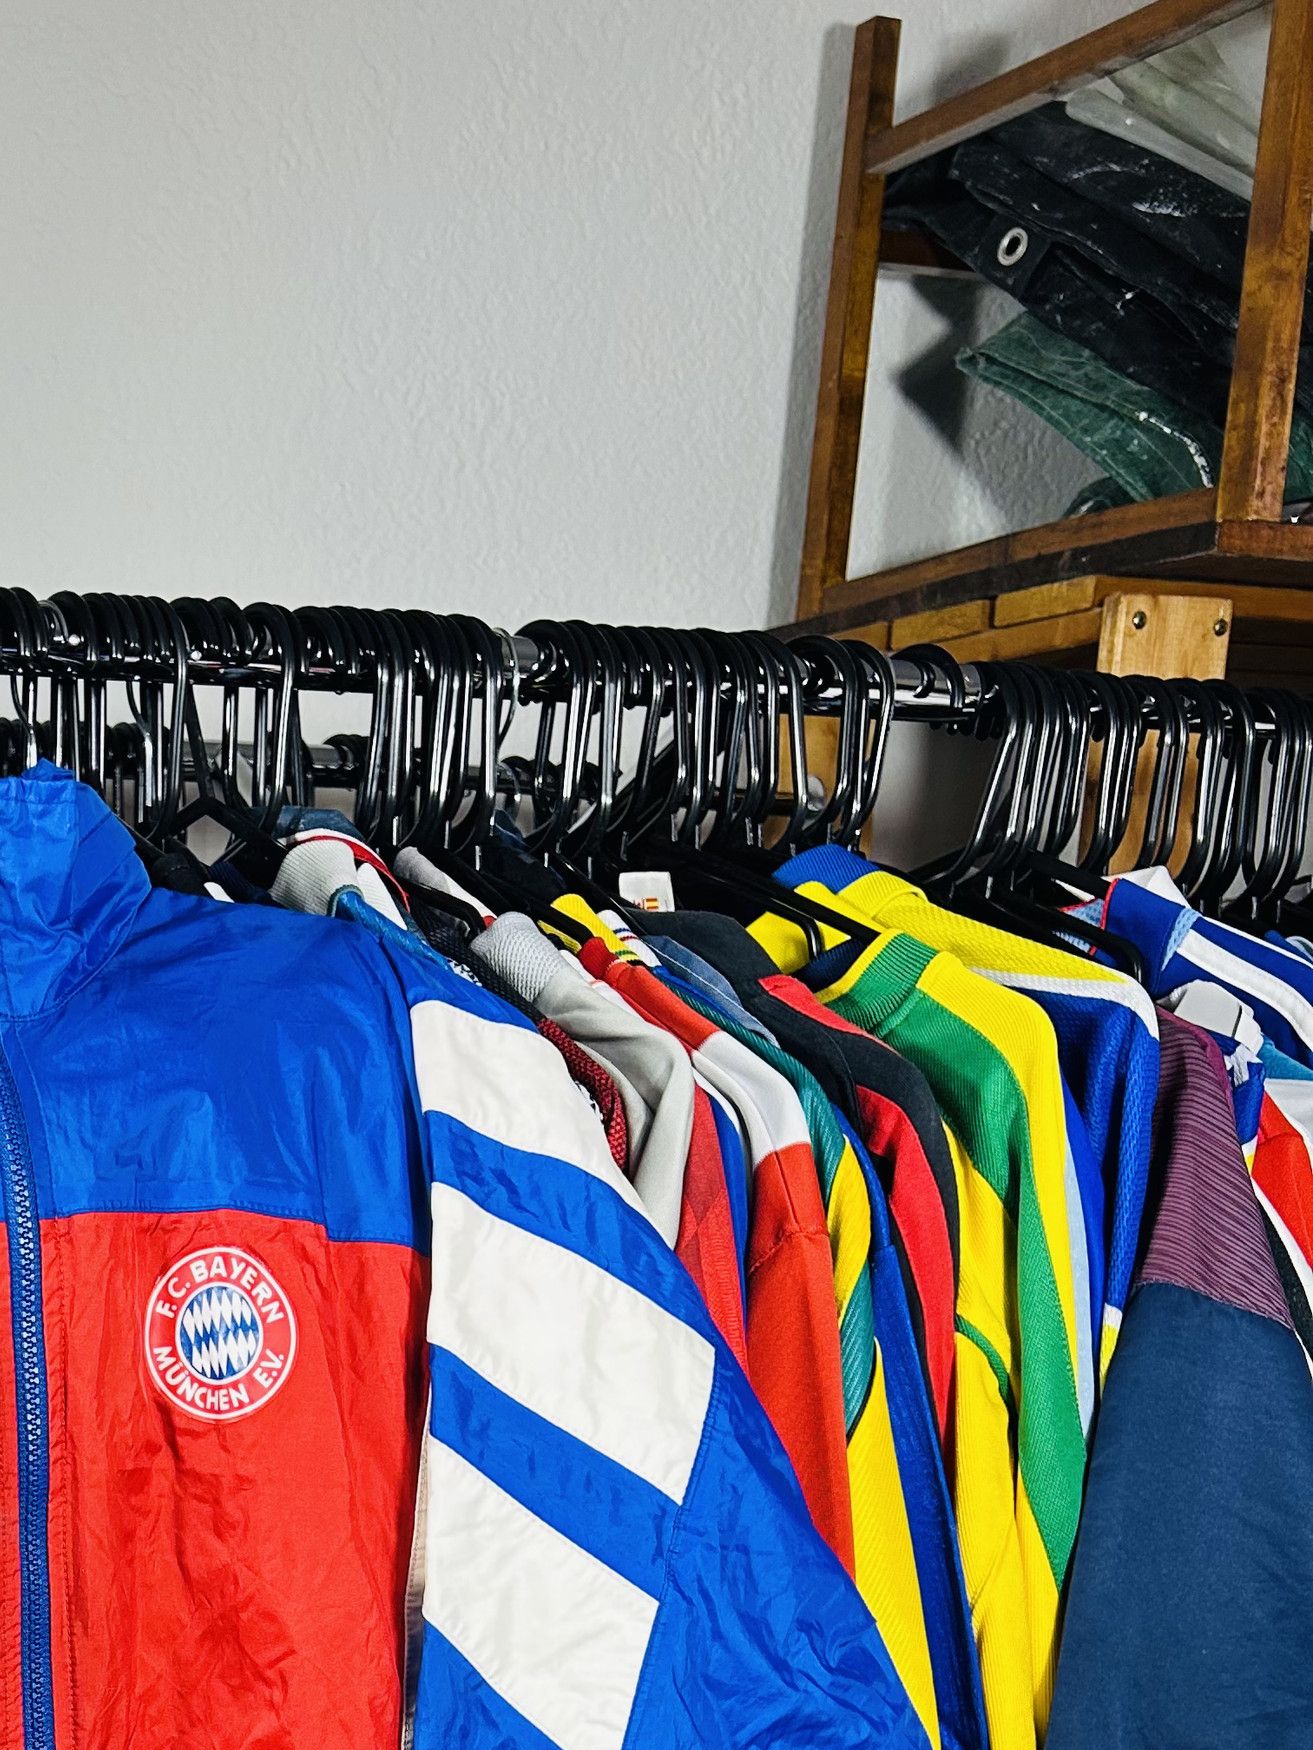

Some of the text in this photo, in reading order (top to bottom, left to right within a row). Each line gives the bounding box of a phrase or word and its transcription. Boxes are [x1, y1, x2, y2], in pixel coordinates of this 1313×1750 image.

[189, 1256, 284, 1323] BAYERN
[154, 1346, 285, 1411] MÜNCHEN E.V.
